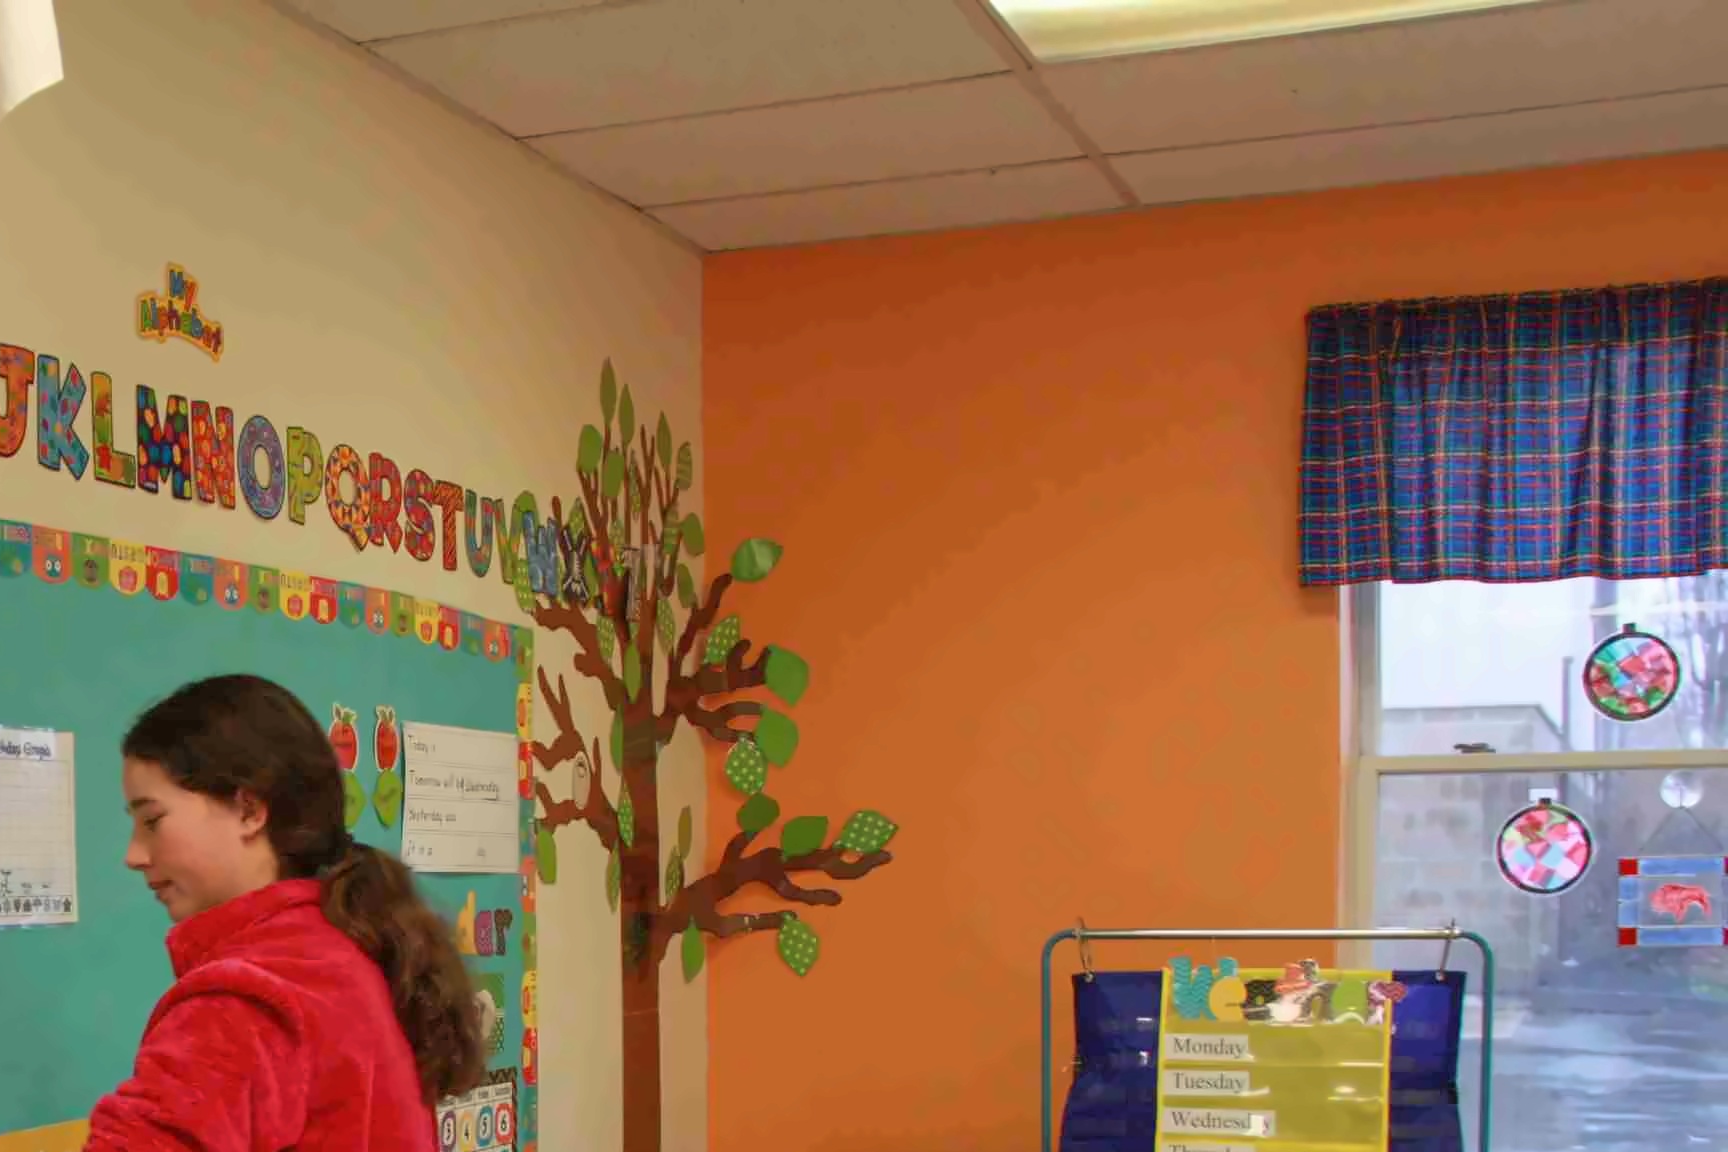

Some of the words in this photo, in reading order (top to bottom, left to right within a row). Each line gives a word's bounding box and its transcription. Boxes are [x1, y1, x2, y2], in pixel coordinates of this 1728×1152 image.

[1173, 1037, 1246, 1060] Monday
[1173, 1073, 1246, 1096] Tuesday
[481, 1117, 488, 1136] 5
[500, 1115, 507, 1133] 6
[1171, 1111, 1272, 1135] Wednesdy
